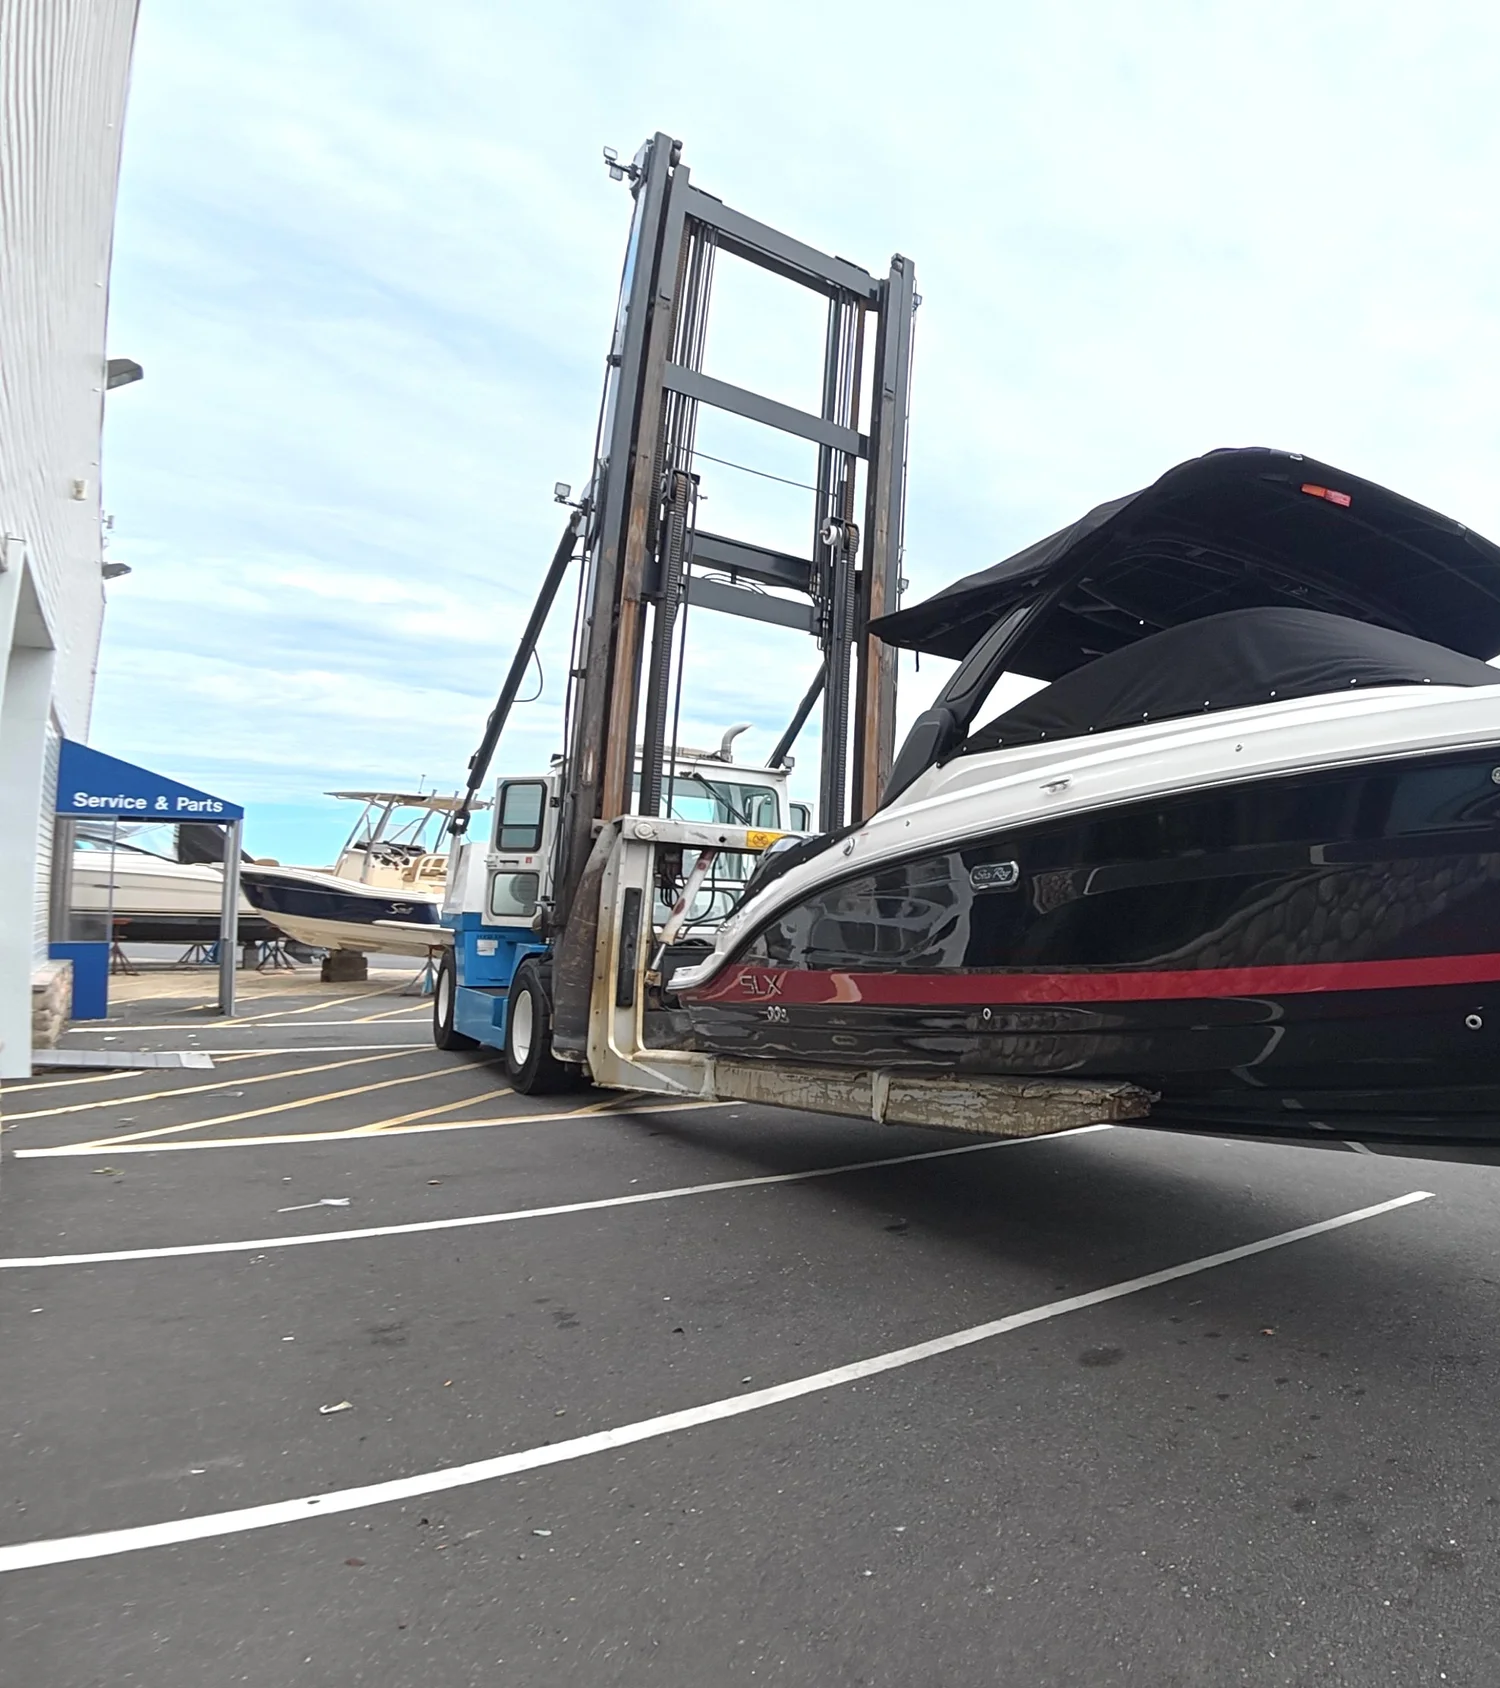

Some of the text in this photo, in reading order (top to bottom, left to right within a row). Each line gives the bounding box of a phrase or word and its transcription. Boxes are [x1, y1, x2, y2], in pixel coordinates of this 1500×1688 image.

[72, 792, 224, 813] Service & Parts
[992, 866, 1012, 881] Ray
[740, 975, 782, 995] SLX
